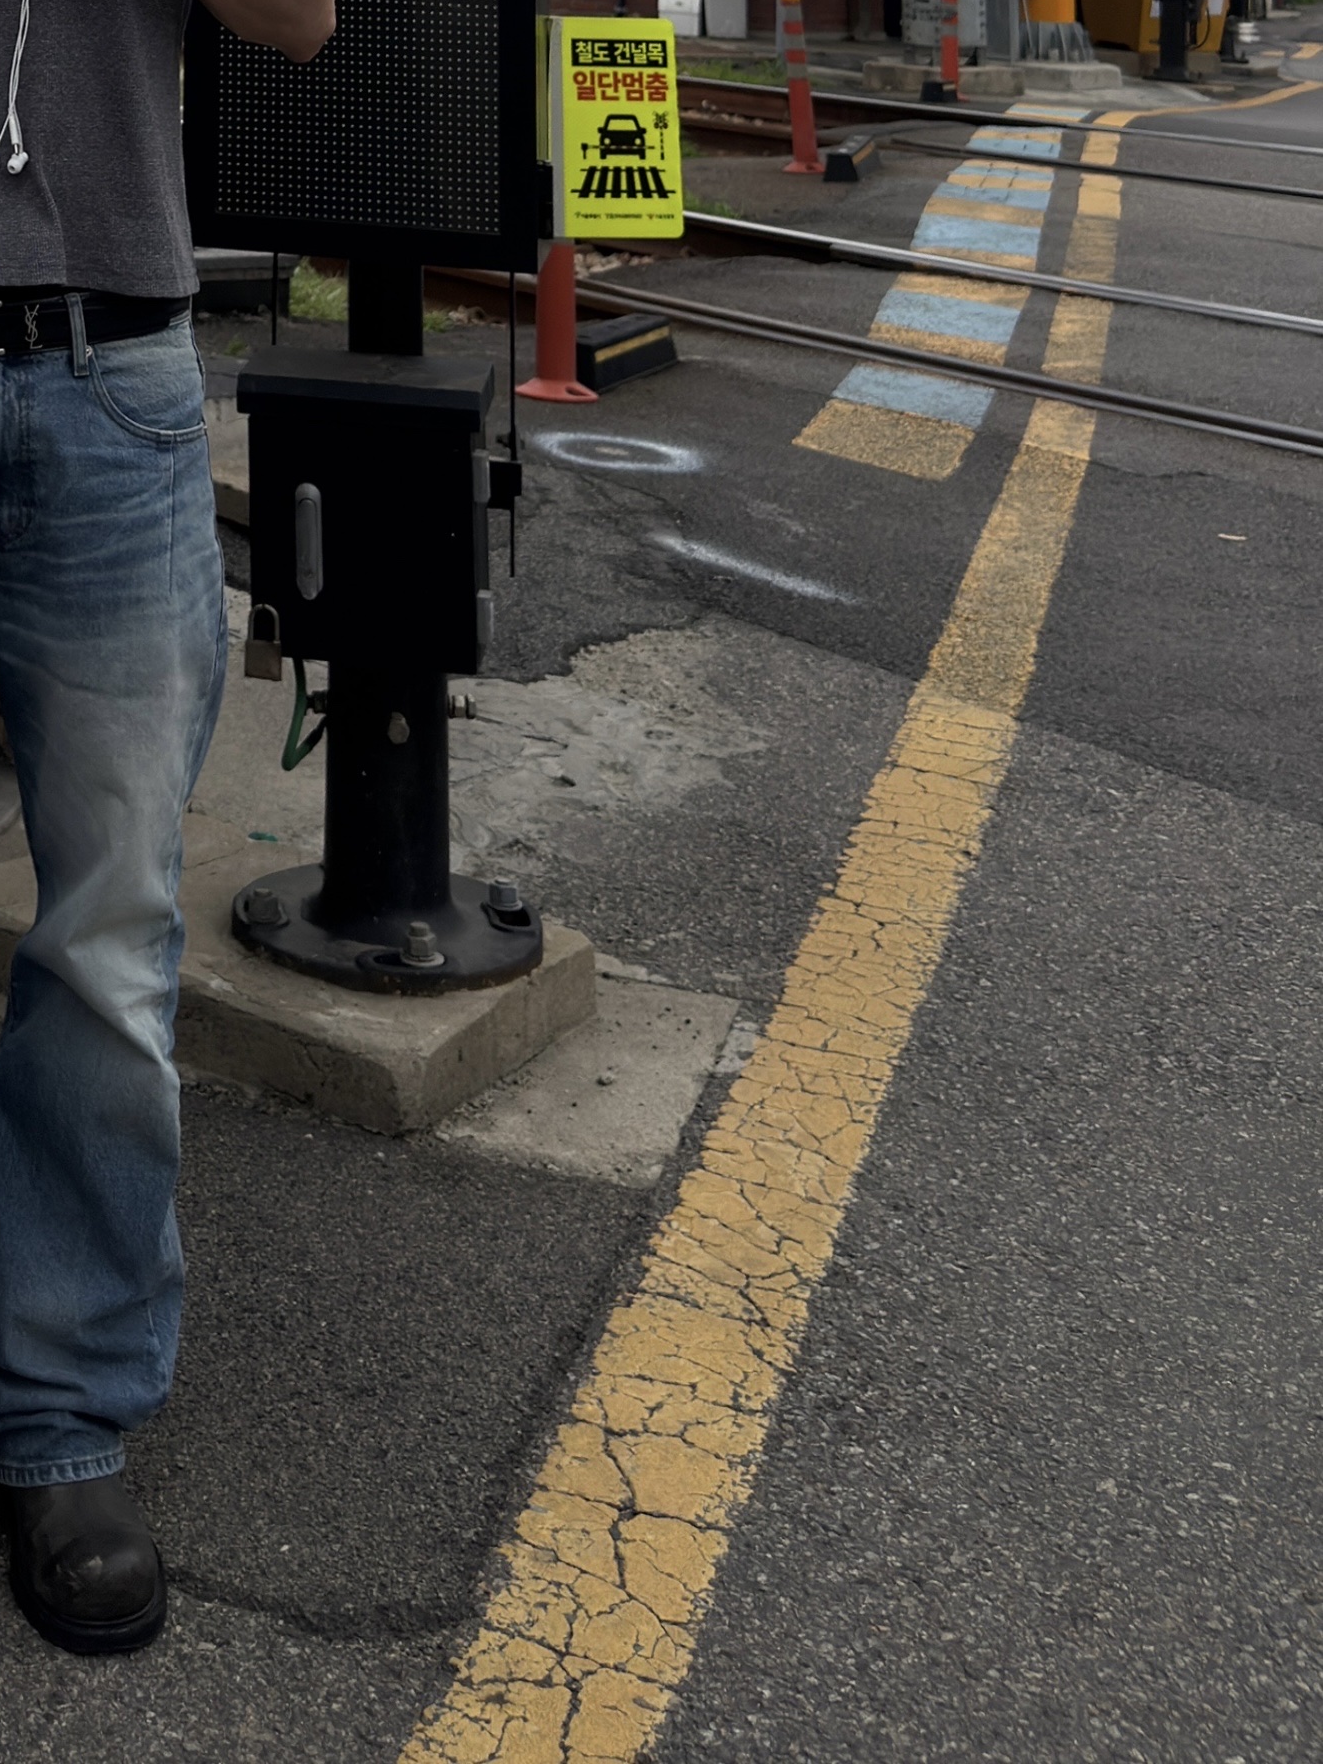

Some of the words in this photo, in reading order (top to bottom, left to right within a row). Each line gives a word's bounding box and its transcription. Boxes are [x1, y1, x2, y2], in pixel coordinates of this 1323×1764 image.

[575, 41, 611, 63] 철도
[614, 42, 665, 65] 건널목
[573, 70, 669, 102] 일단멈춤
